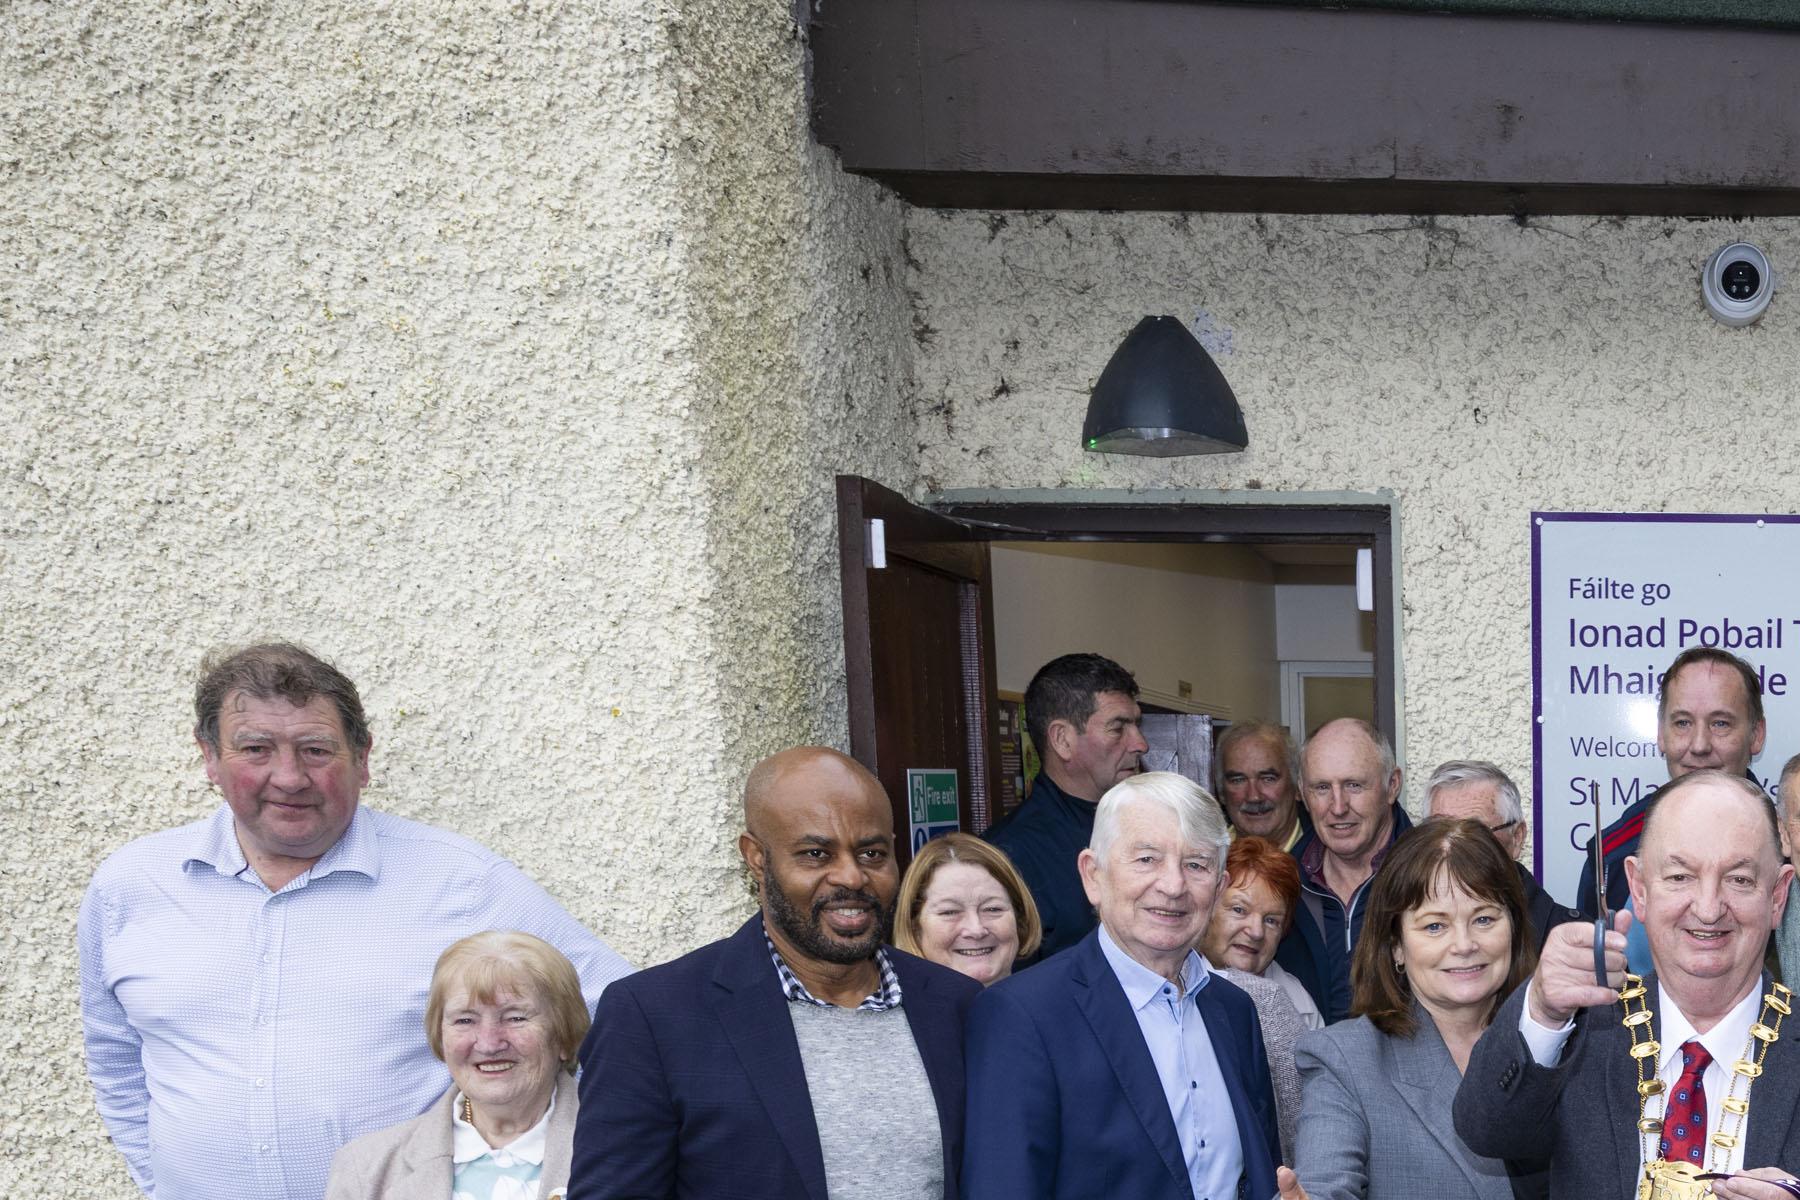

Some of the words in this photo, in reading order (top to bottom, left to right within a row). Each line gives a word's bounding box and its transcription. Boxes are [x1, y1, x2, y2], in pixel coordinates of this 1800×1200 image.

[1569, 577, 1634, 600] Fáilte
[1641, 584, 1671, 606] go
[1570, 617, 1665, 648] Ionad
[1679, 618, 1782, 649] Pobail
[1570, 736, 1666, 758] Welcom
[926, 786, 940, 805] Fire
[941, 786, 956, 805] exit
